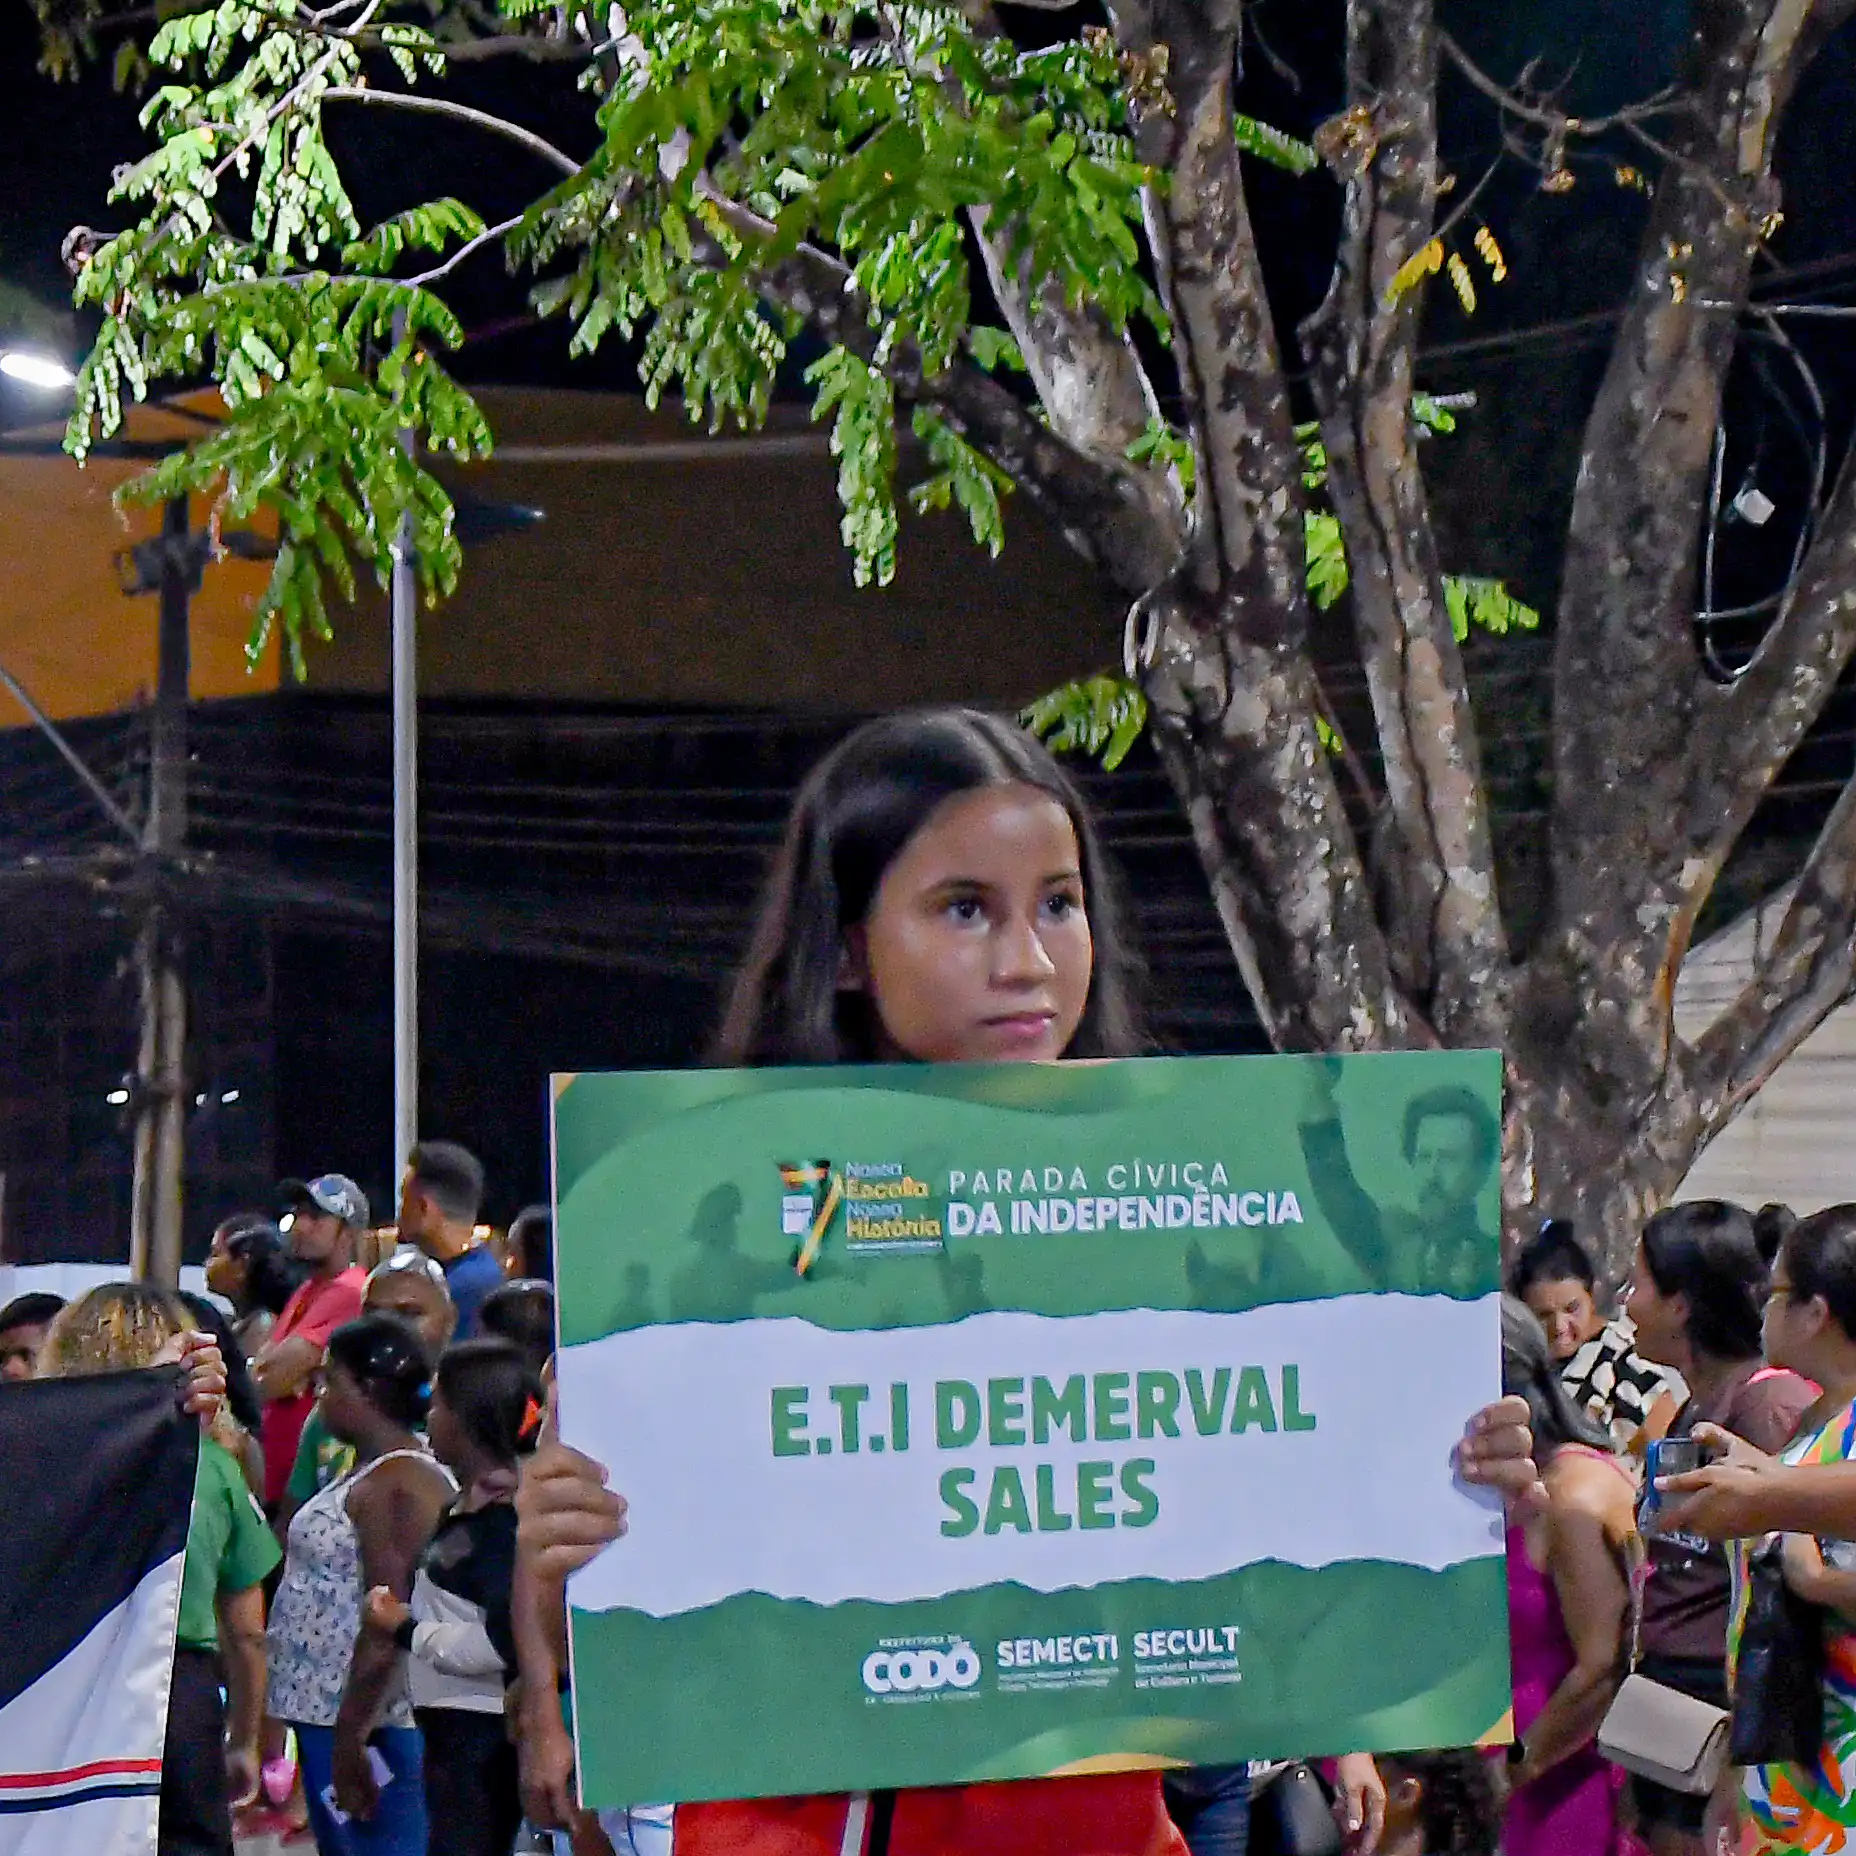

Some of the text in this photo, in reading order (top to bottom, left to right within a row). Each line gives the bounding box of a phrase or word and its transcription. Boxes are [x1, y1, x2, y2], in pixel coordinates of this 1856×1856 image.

[949, 1157, 1229, 1195] PARADA CÍVICA
[947, 1187, 1305, 1237] DA INDEPENDÊNCIA
[771, 1363, 1318, 1458] E.T.I DEMERVAL
[939, 1457, 1160, 1539] SALES
[997, 1634, 1119, 1667] SEMECTI
[1133, 1626, 1241, 1658] SECULT
